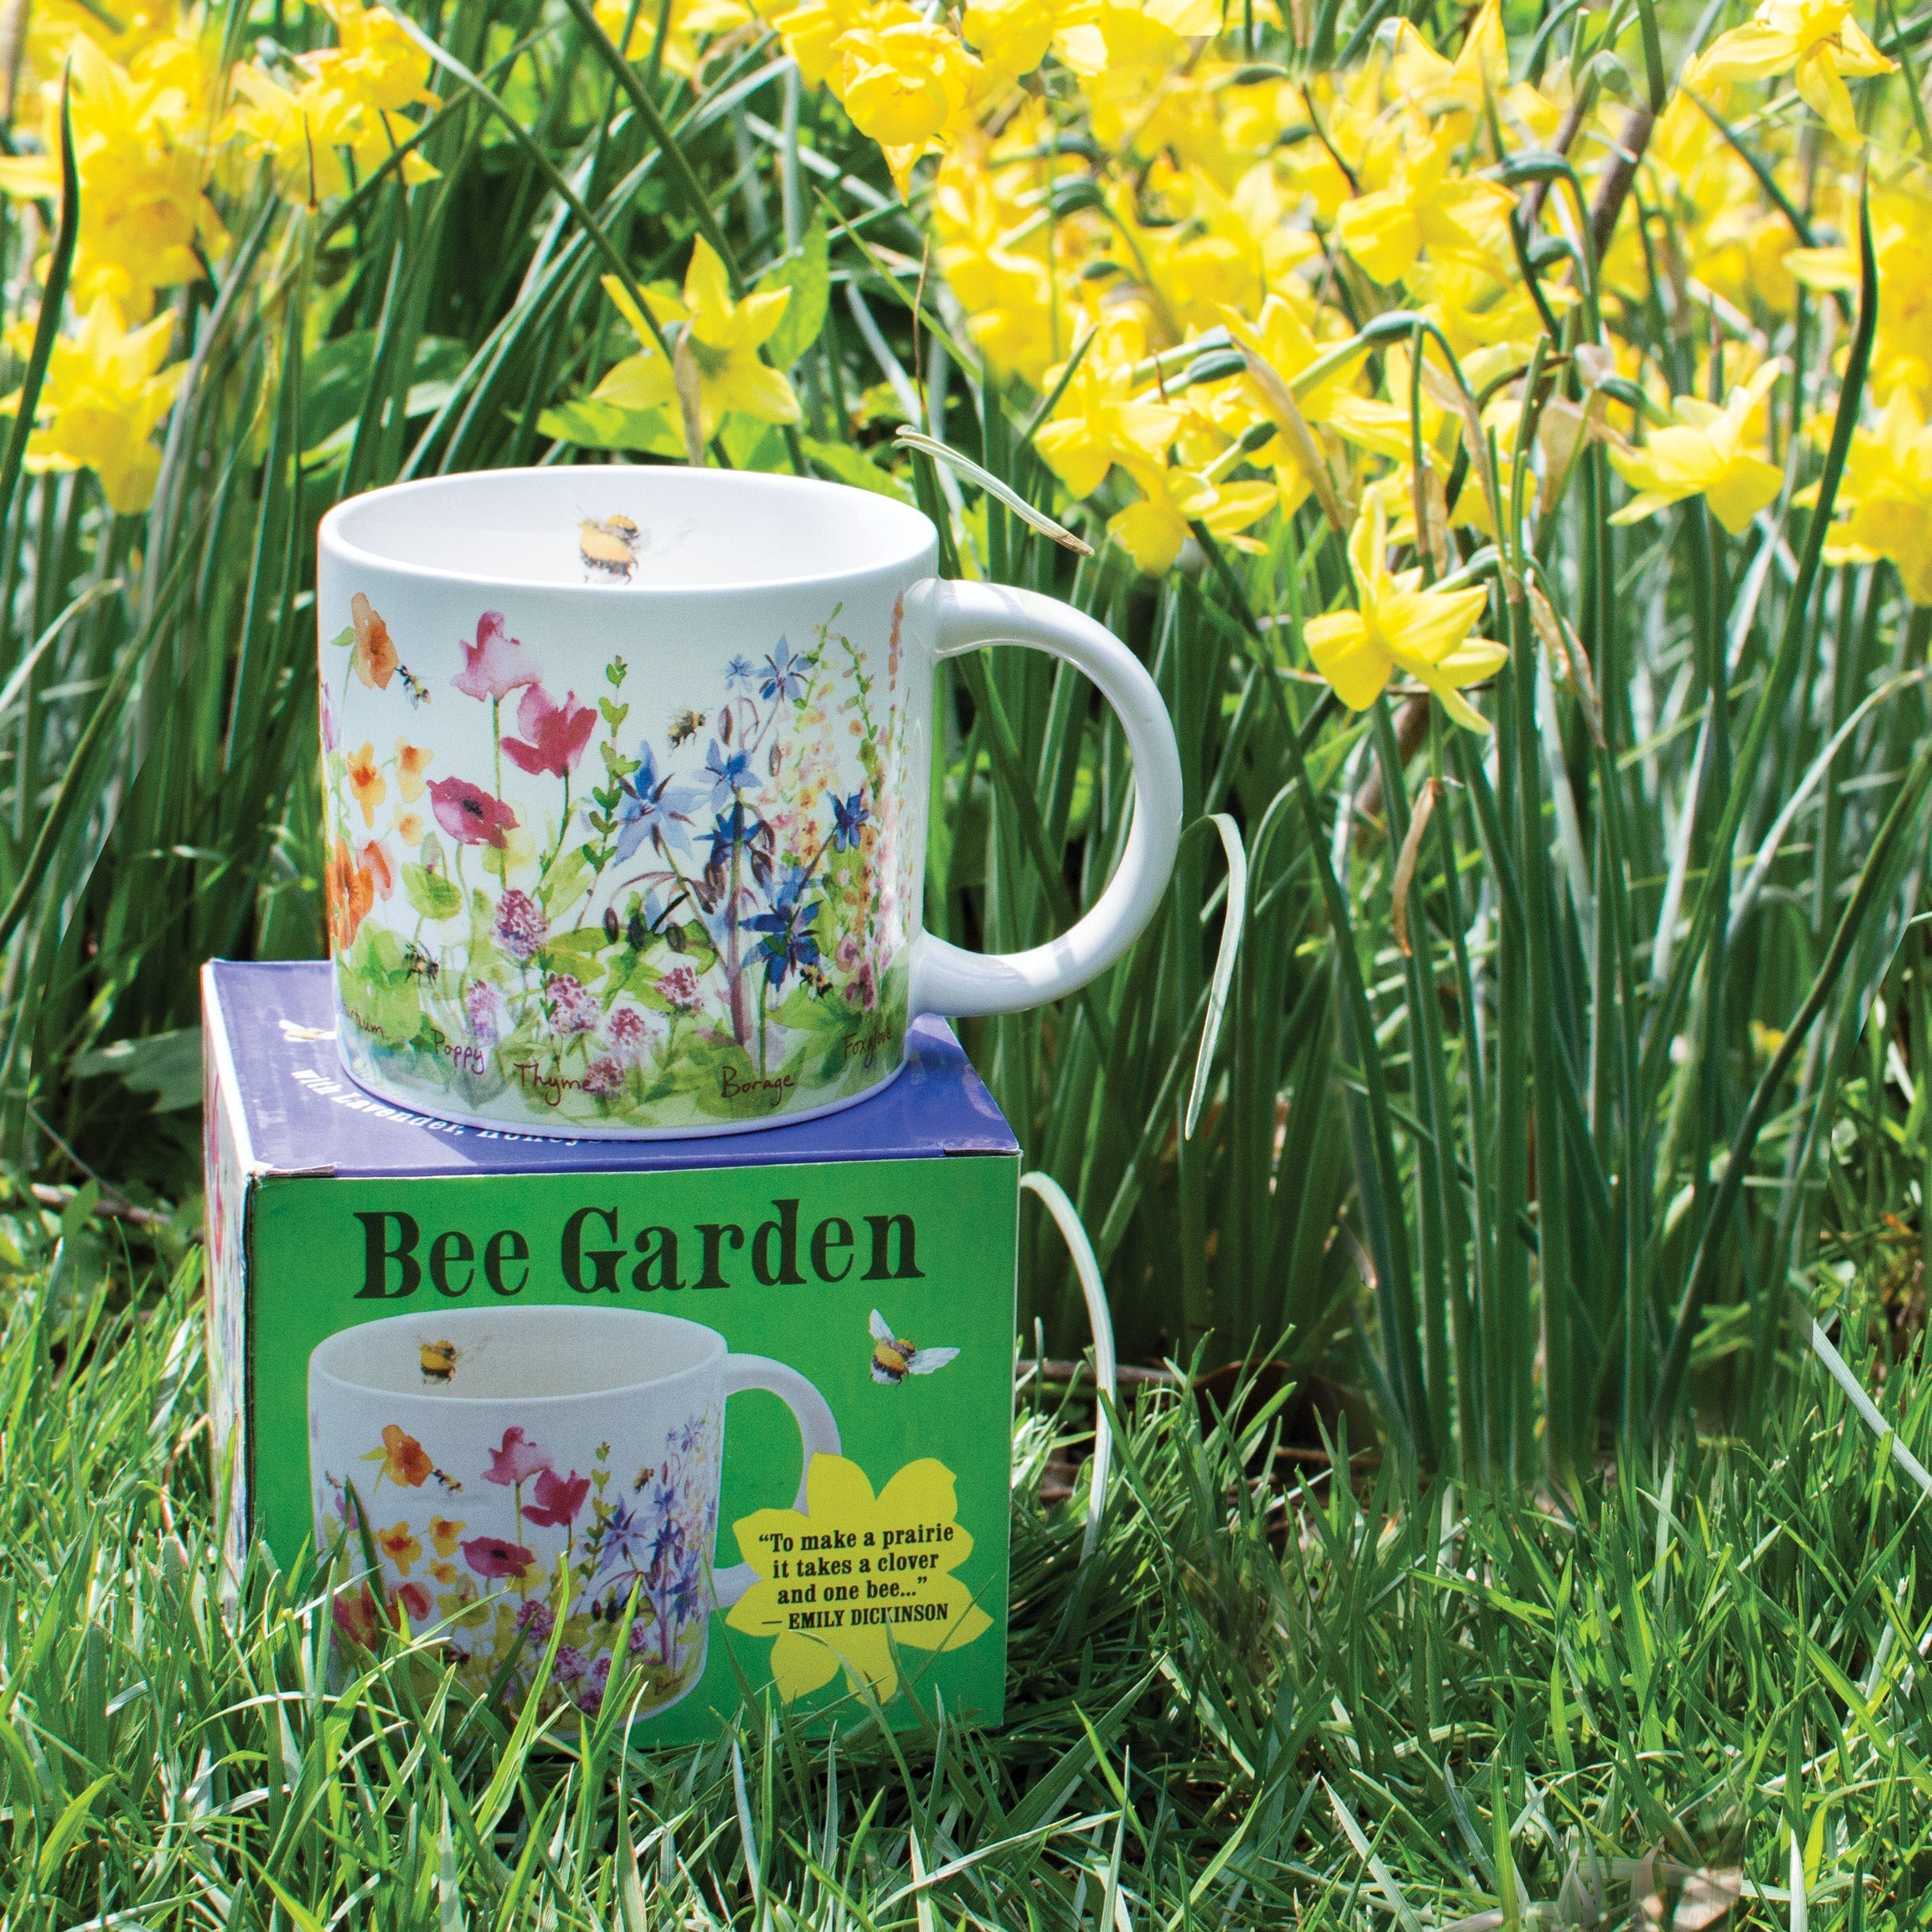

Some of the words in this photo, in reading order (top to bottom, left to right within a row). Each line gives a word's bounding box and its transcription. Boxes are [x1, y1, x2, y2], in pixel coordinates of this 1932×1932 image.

[431, 1029, 485, 1075] Poppy
[513, 1063, 597, 1106] Thyme
[721, 1066, 795, 1107] Borage
[353, 1211, 530, 1298] Bee
[563, 1199, 926, 1294] Garden
[758, 1532, 794, 1553] “To
[801, 1530, 857, 1550] make
[864, 1530, 875, 1546] a
[882, 1523, 954, 1550] prairie
[773, 1559, 790, 1579] it
[797, 1557, 852, 1577] takes
[859, 1557, 871, 1573] a
[877, 1552, 939, 1571] clover
[778, 1583, 816, 1604] and
[824, 1583, 859, 1602] one
[866, 1575, 927, 1600] bee...”
[788, 1610, 845, 1630] EMILY
[851, 1603, 949, 1627] DICKINSON
